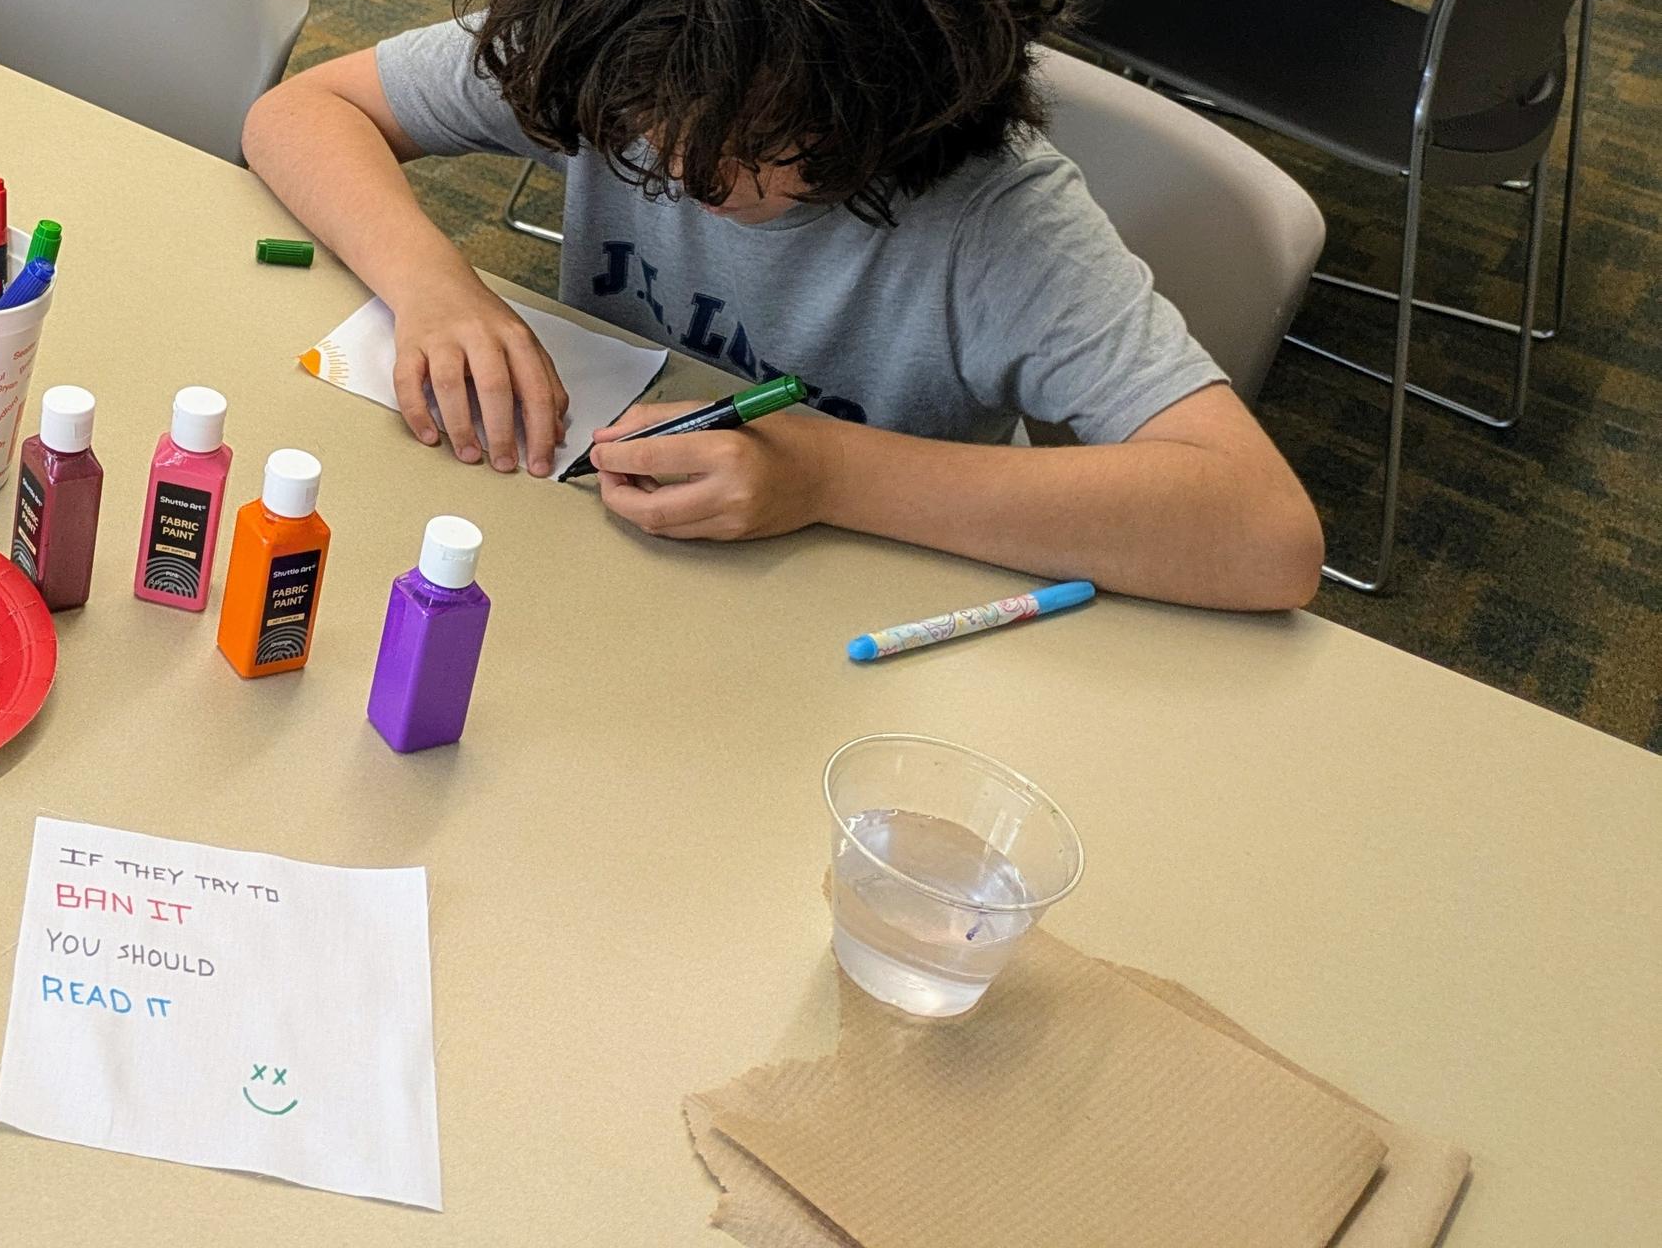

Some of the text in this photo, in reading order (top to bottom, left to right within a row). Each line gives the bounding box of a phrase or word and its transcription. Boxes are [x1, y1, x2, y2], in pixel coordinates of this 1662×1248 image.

[159, 495, 189, 509] Shuttle
[160, 515, 200, 532] FABRIC
[161, 526, 195, 541] PAINT
[272, 568, 300, 579] Shuttle
[272, 584, 309, 599] FABRIC
[273, 595, 304, 609] PAINT
[59, 847, 280, 903] IF THEY TRY TO
[56, 883, 193, 925] BAN IT
[46, 928, 216, 977] YOU SHOULD
[42, 975, 172, 1018] READ IT
